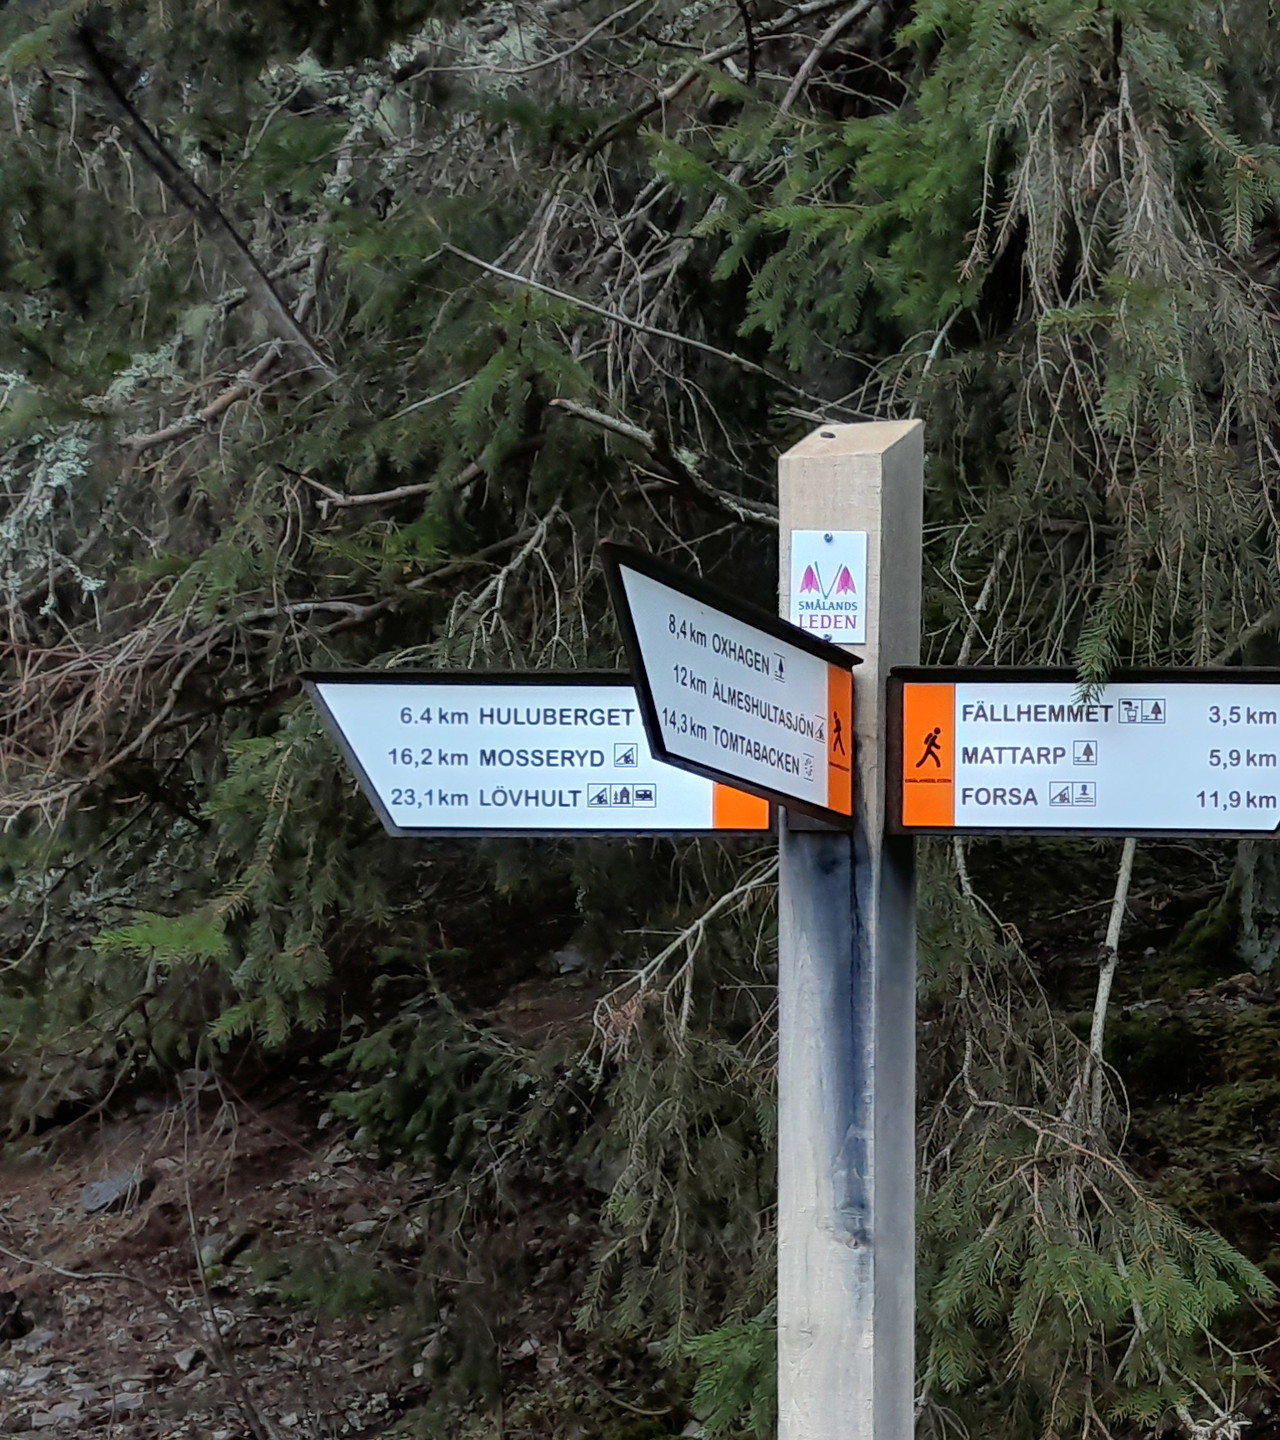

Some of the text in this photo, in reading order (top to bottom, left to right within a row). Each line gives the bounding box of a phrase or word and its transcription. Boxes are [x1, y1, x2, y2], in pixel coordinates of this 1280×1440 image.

[798, 599, 858, 610] SMÅLANDS
[799, 614, 857, 628] LEDEN
[668, 614, 770, 676] 8,4 km OXHAGEN
[673, 664, 814, 738] 12 km ÄLMESHULTASJÖN
[438, 708, 468, 724] km
[480, 708, 635, 726] HULUBERGET
[962, 701, 1114, 723] FÄLLHEMMET
[1209, 706, 1276, 726] 3,5 km
[662, 707, 800, 776] 14,3 km TOMTABACKEN
[388, 748, 604, 768] 16,2 km MOSSERYD
[962, 746, 1066, 764] MATTARP
[1209, 749, 1276, 770] 5,9 km
[480, 786, 581, 807] LÖVHULT
[962, 787, 1038, 806] FORSA
[1196, 790, 1276, 811] 11,9 km
